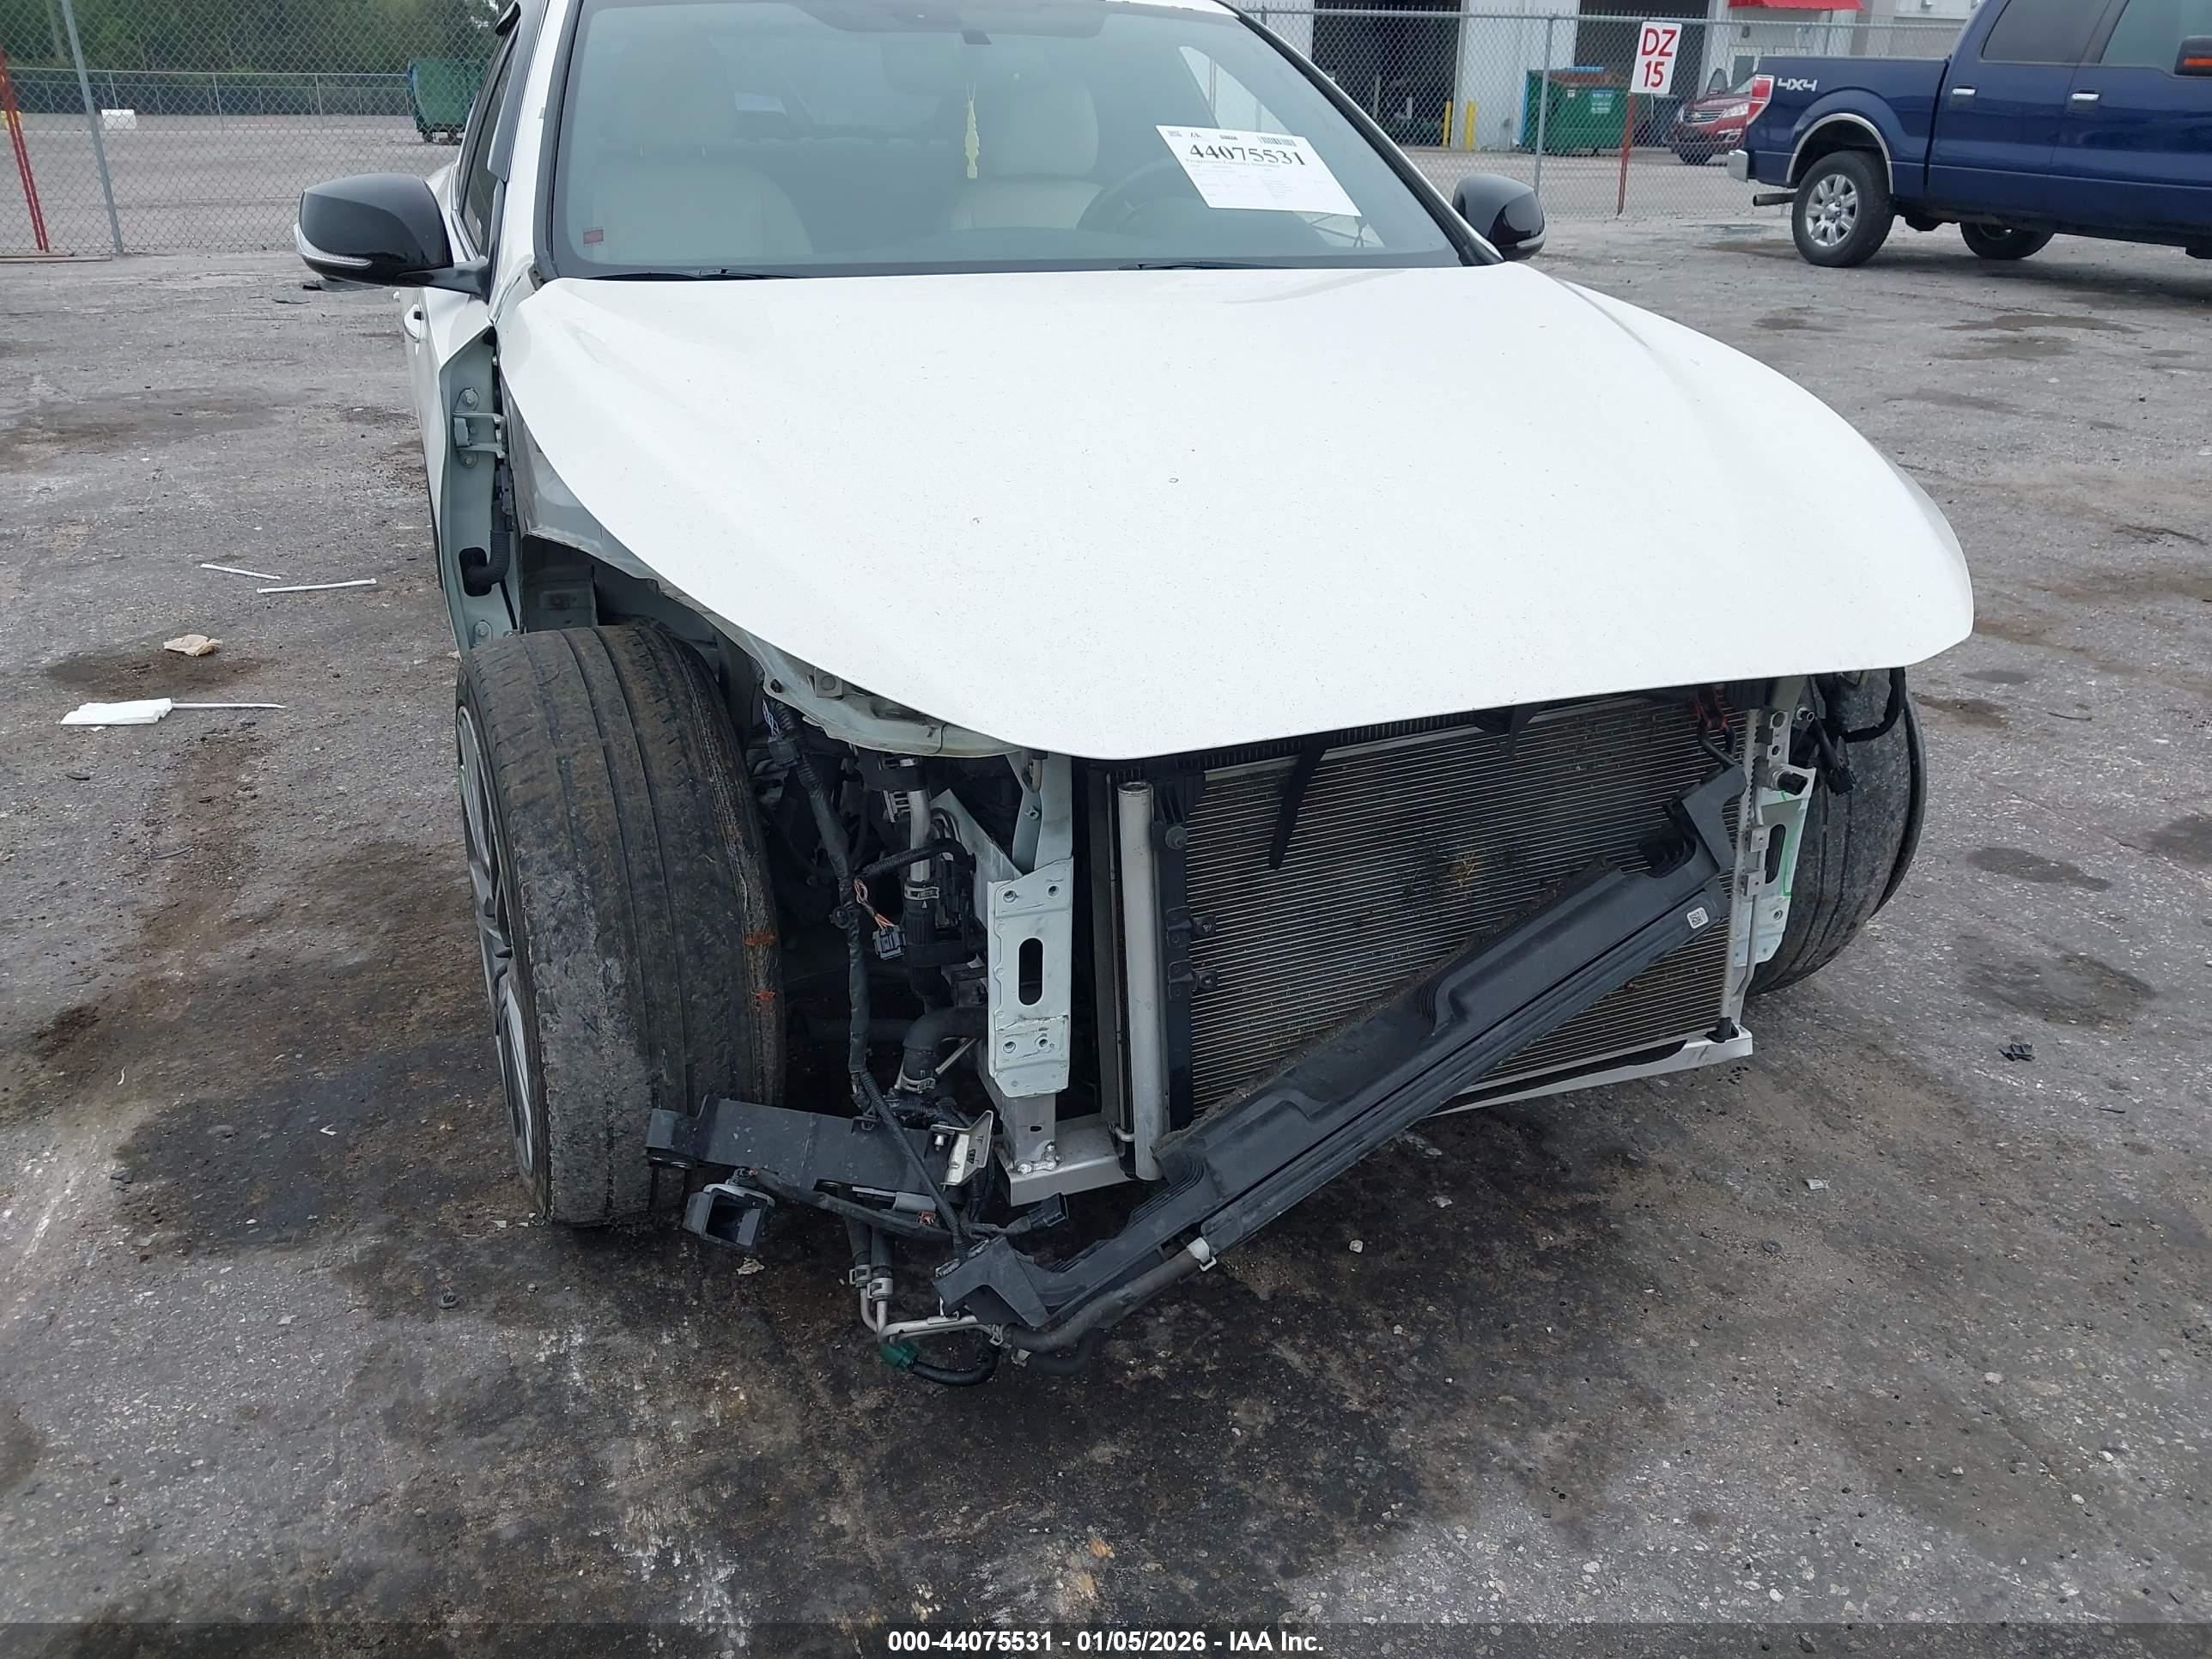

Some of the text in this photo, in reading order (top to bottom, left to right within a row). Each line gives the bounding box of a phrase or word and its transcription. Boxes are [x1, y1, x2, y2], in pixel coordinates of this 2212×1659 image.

[1641, 27, 1677, 58] DZ
[1644, 60, 1666, 88] 15
[1189, 143, 1306, 166] 44075531
